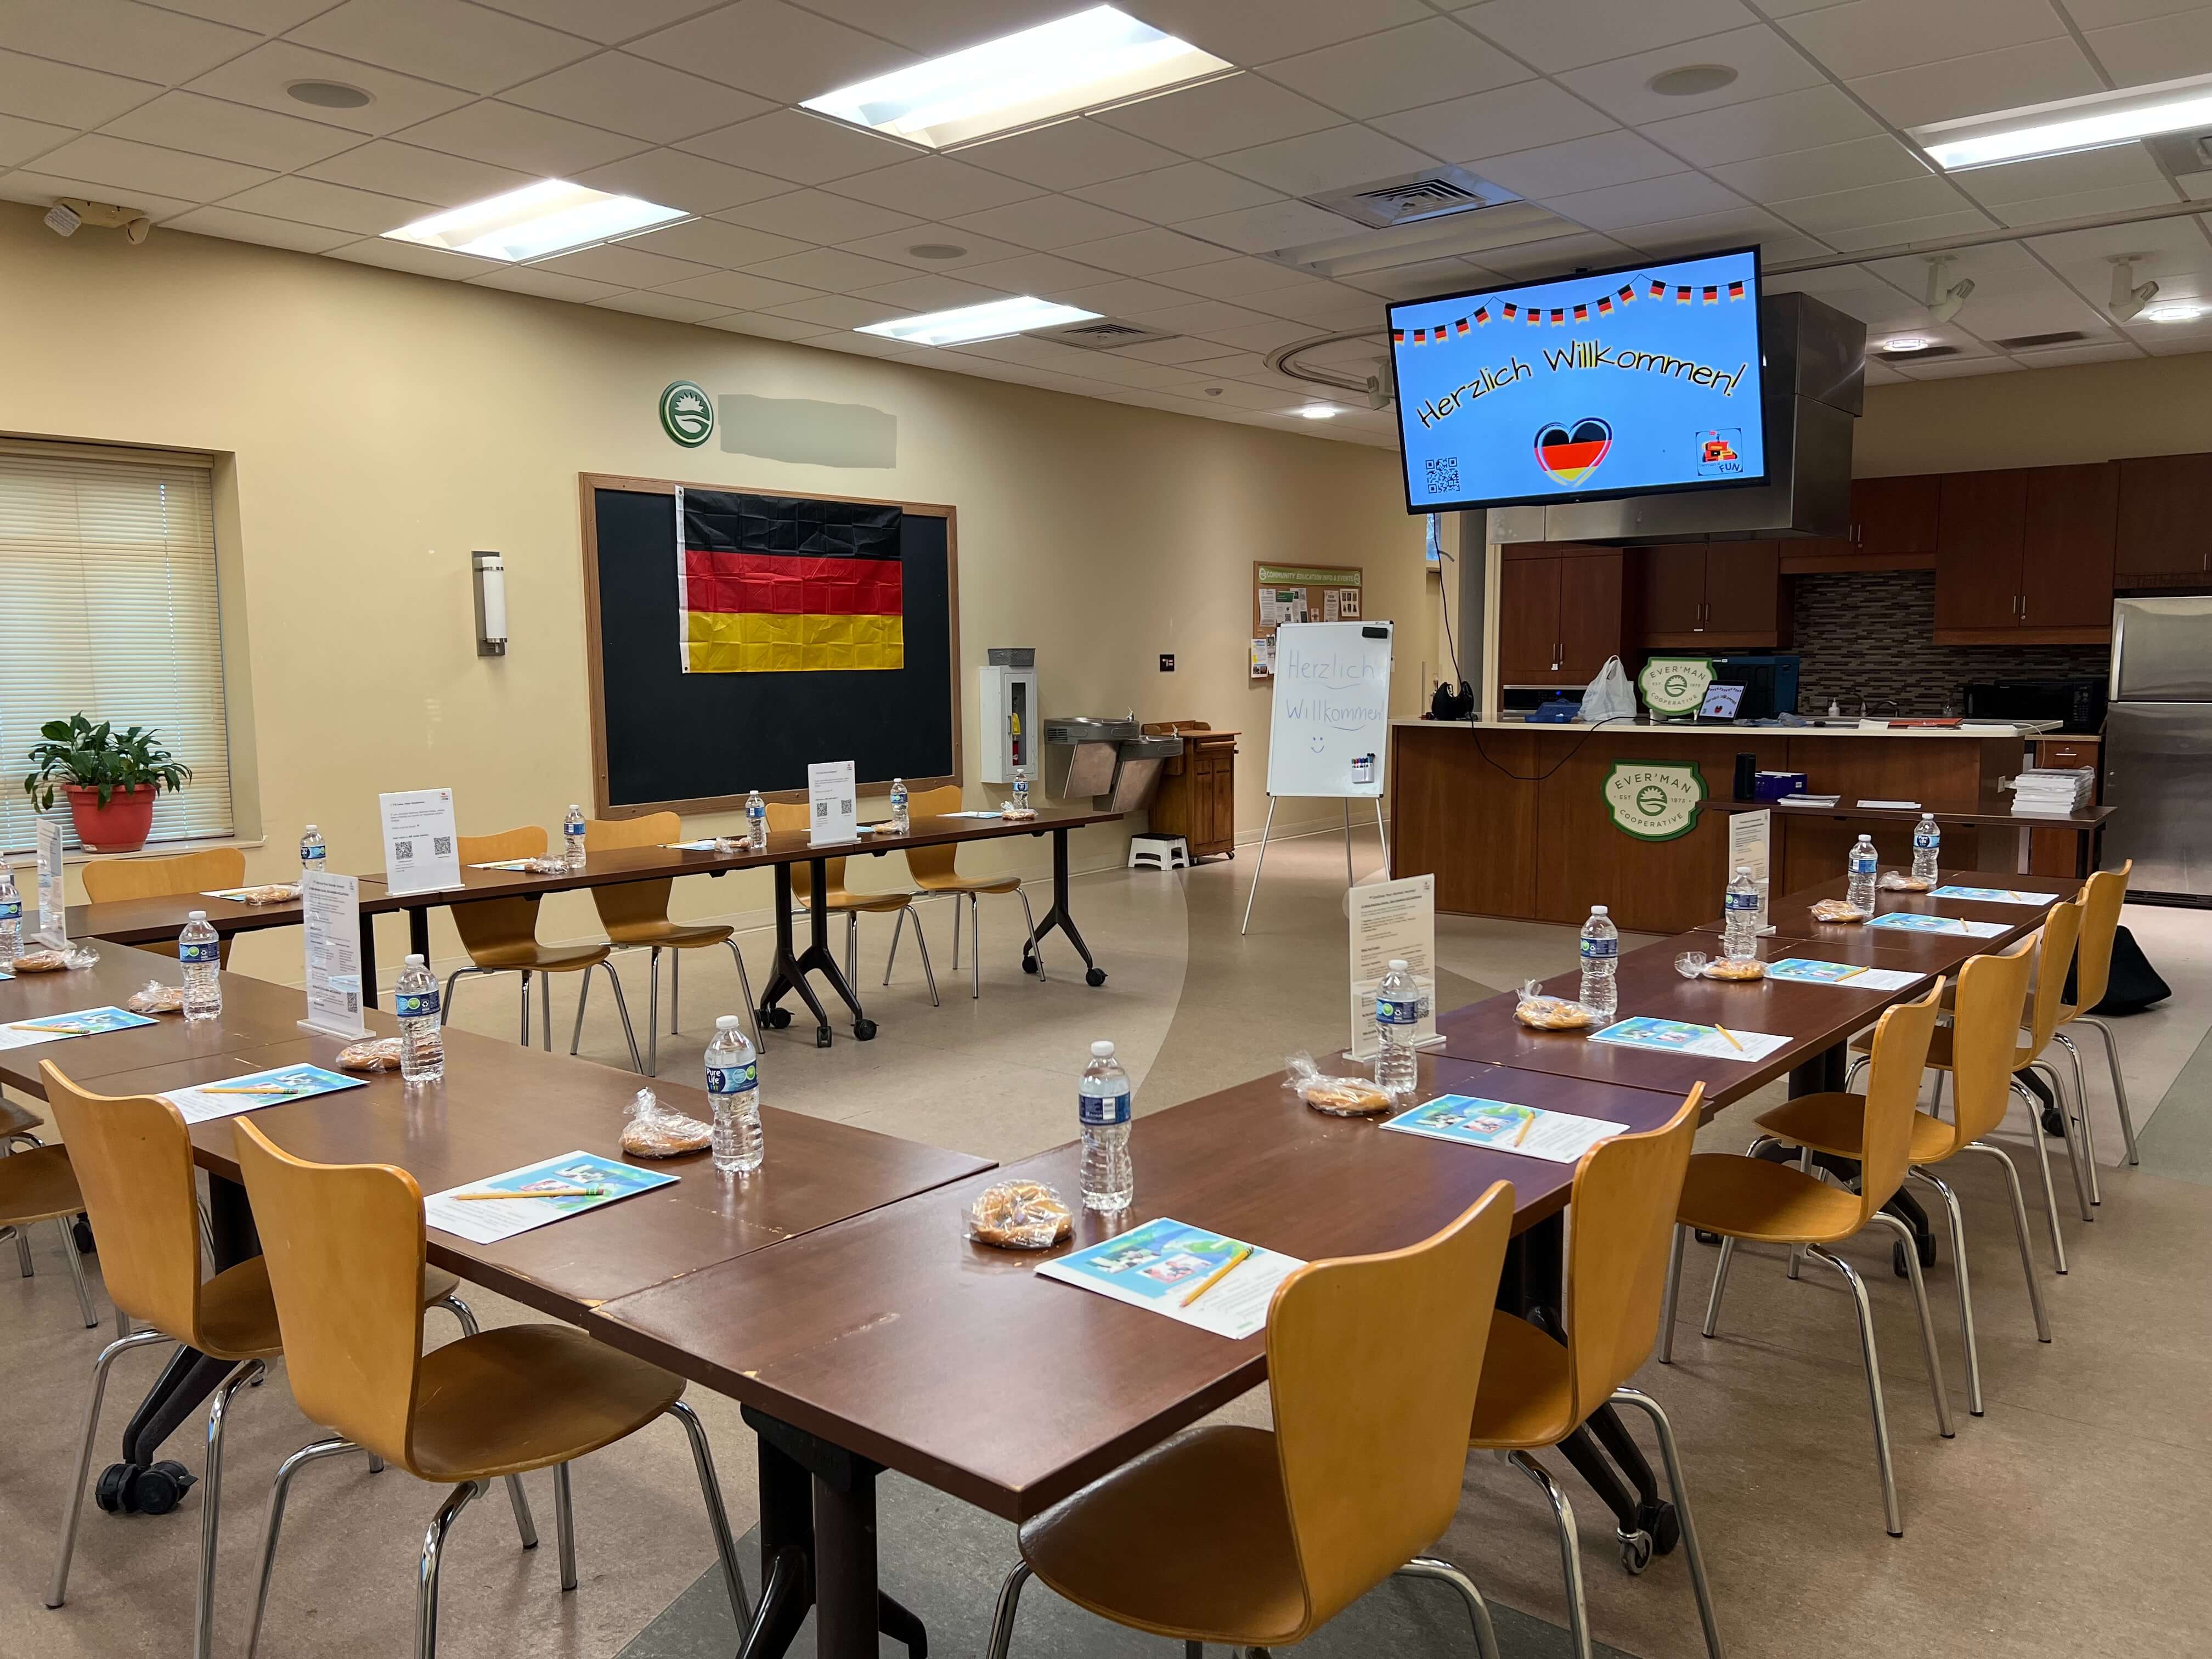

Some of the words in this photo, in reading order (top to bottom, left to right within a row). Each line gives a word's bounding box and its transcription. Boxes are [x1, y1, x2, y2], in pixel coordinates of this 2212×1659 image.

[1417, 356, 1532, 428] Herzlich
[1543, 339, 1746, 396] Willkommen!
[1719, 463, 1740, 472] FUN
[1266, 571, 1295, 579] COMMUNITY
[1288, 649, 1374, 679] Herzlich
[1650, 666, 1706, 680] EVER'MAN
[1651, 692, 1697, 705] COOPERATIVE
[1615, 773, 1691, 793] EVER'MAN
[1620, 809, 1683, 827] COOPERATIVE
[707, 1068, 721, 1076] Pure
[708, 1075, 720, 1085] Life
